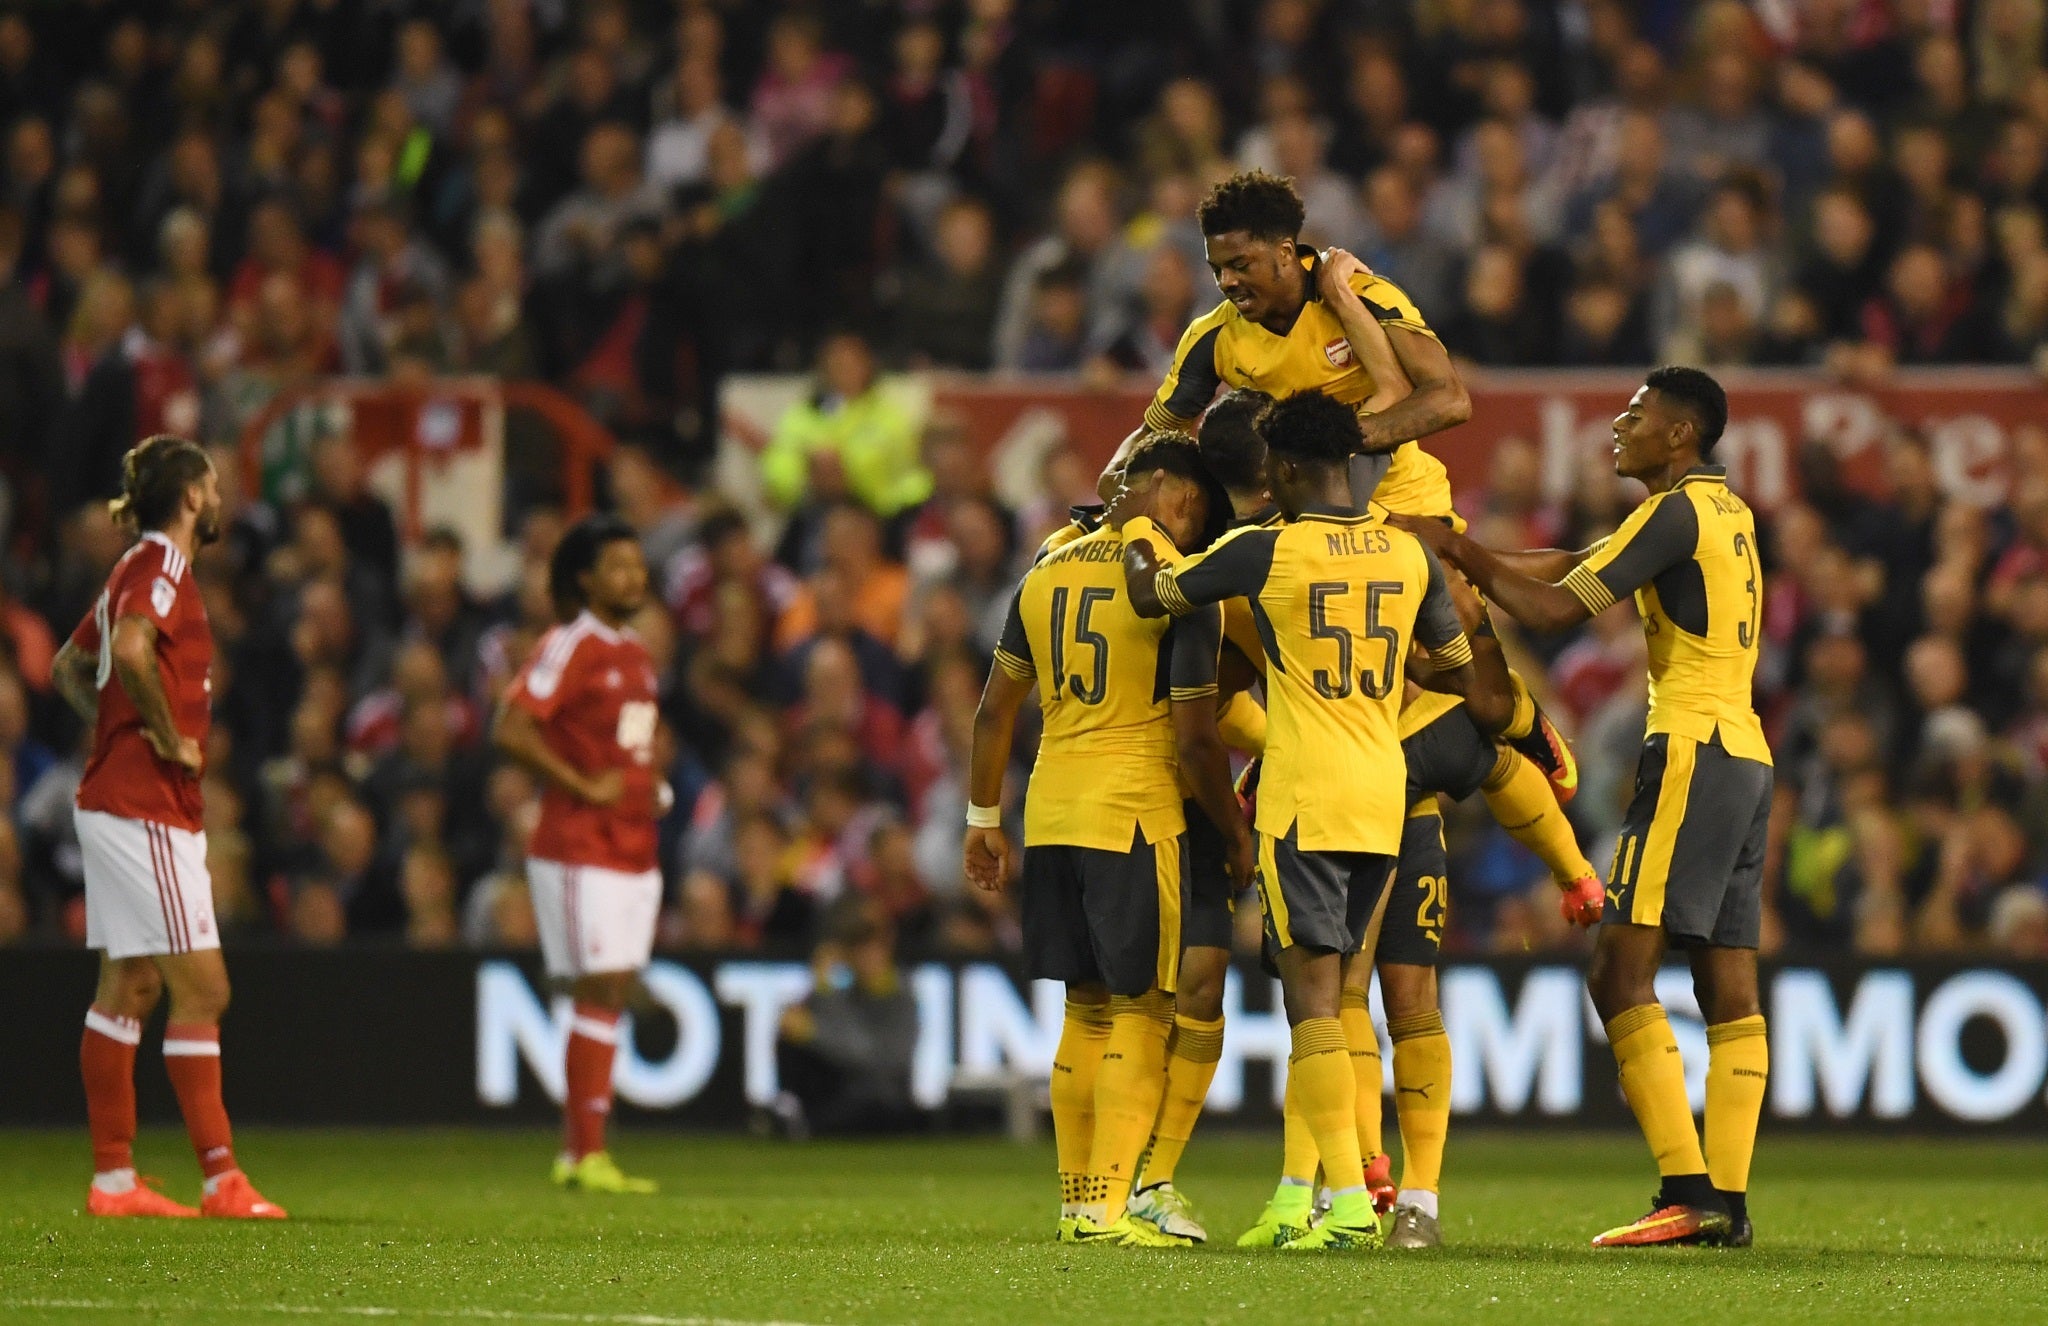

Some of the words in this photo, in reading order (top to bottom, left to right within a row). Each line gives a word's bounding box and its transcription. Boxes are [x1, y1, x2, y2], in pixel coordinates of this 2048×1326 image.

[1325, 529, 1391, 556] NILES
[1050, 586, 1116, 706] 15
[1309, 581, 1404, 700] 55
[1769, 967, 2047, 1122] MO
